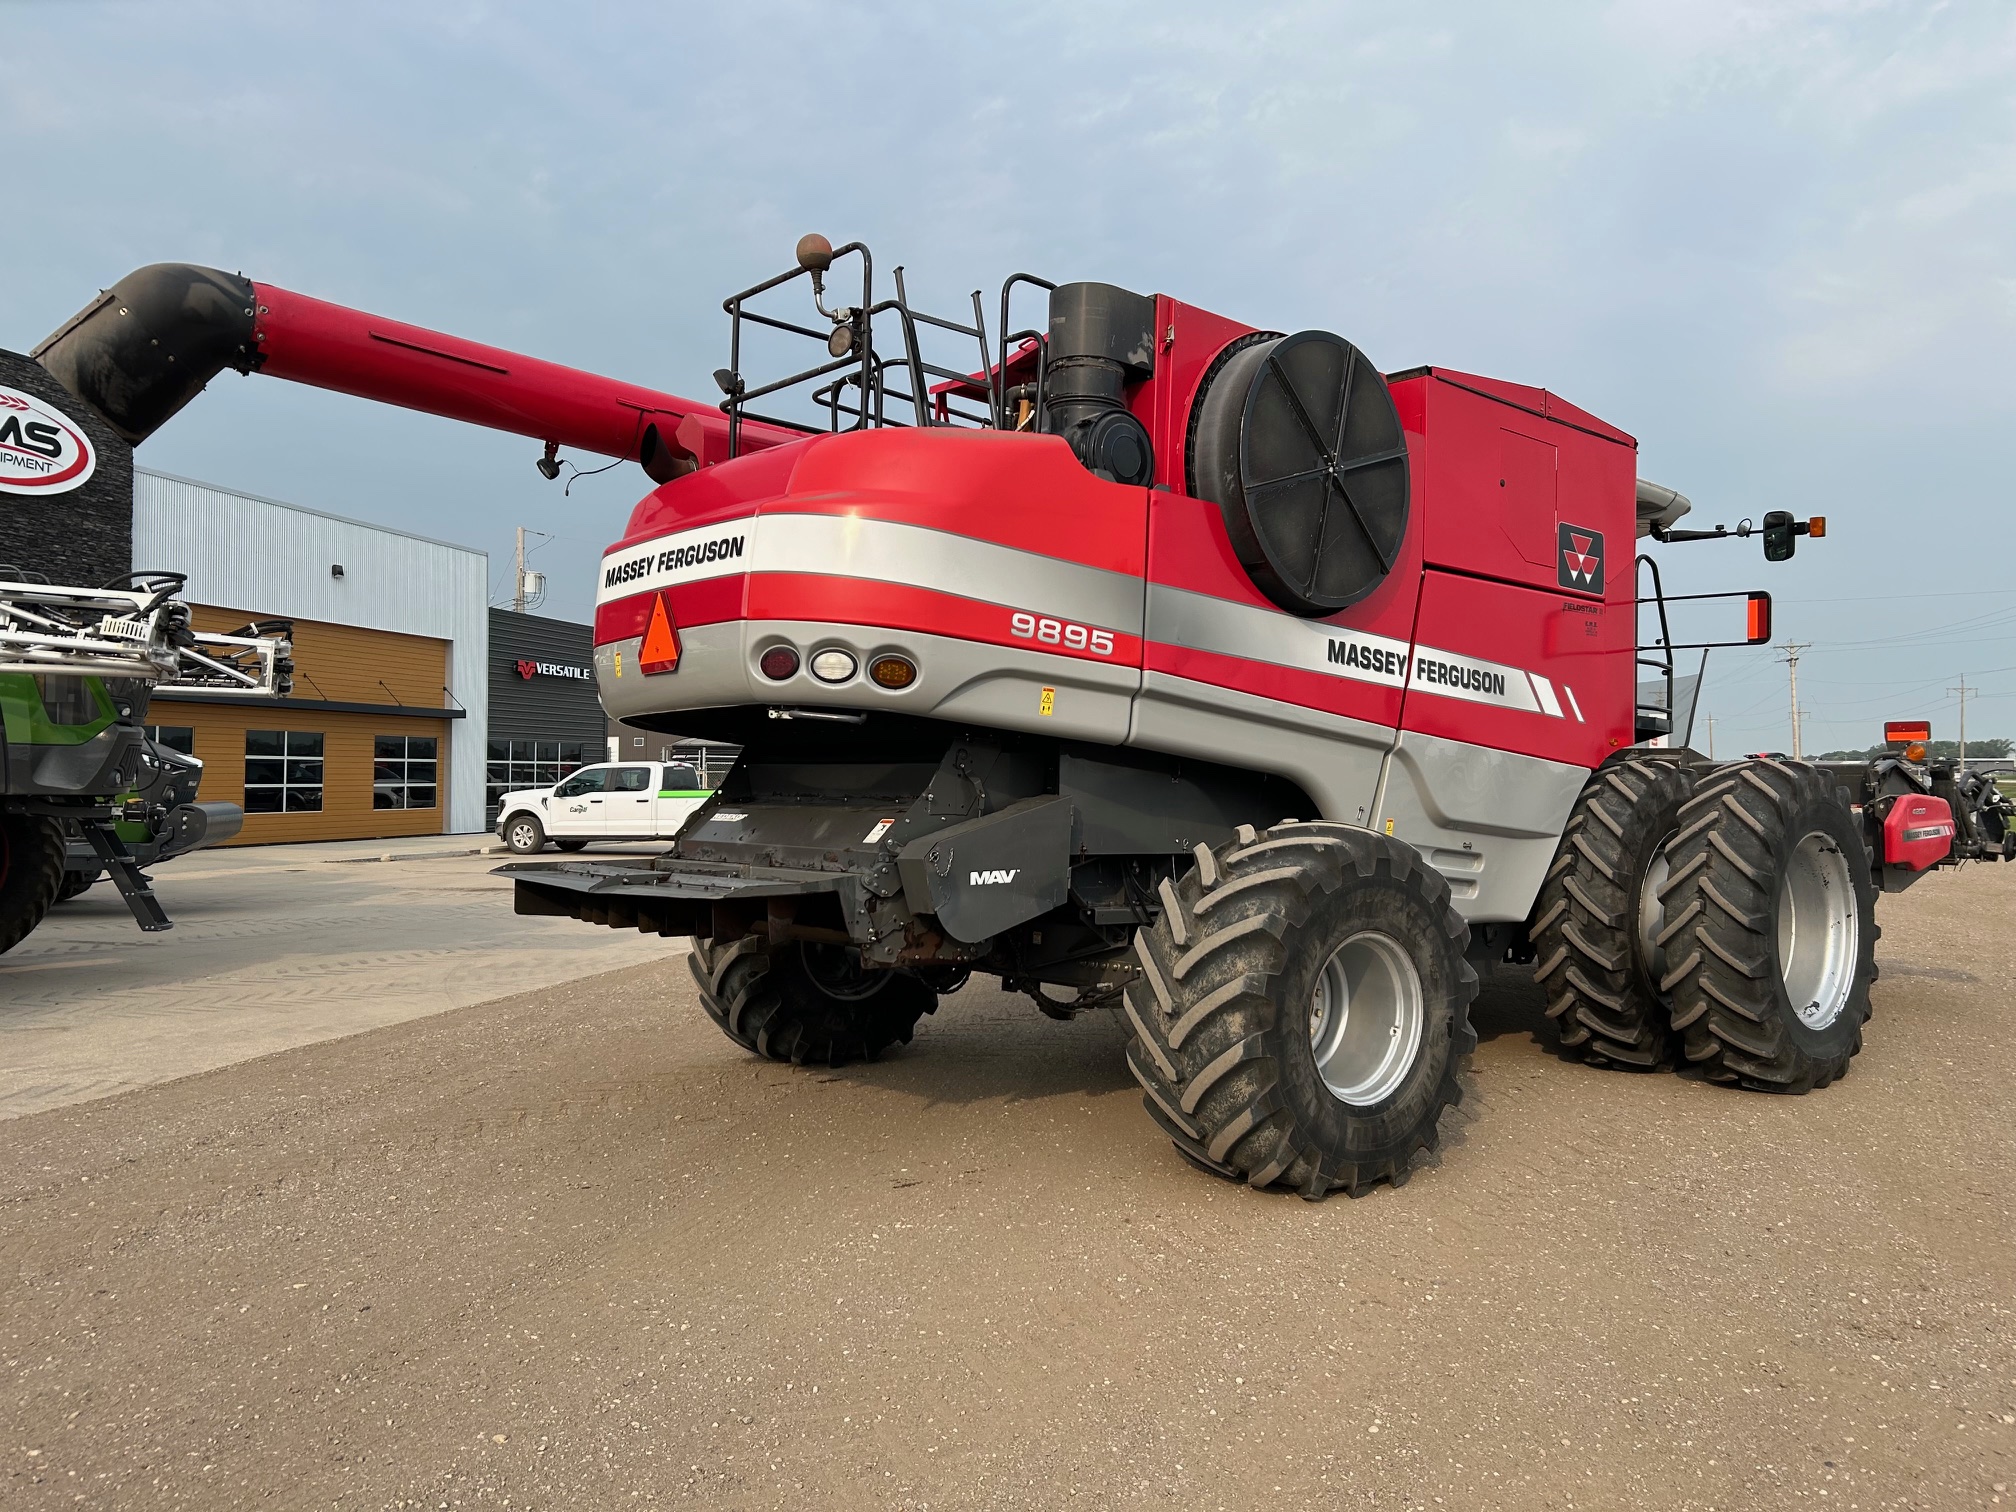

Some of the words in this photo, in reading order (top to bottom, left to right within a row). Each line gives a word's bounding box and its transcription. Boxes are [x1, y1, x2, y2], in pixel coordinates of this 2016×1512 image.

[604, 555, 655, 588] MASSEY
[656, 535, 745, 573] FERGUSON
[1563, 602, 1598, 614] FIELDSTAR
[1010, 612, 1115, 655] 9895
[536, 662, 590, 680] VERSATILE
[1327, 638, 1408, 677] MASSEY
[1416, 658, 1505, 696] FERGUSON
[970, 869, 1017, 886] MAV
